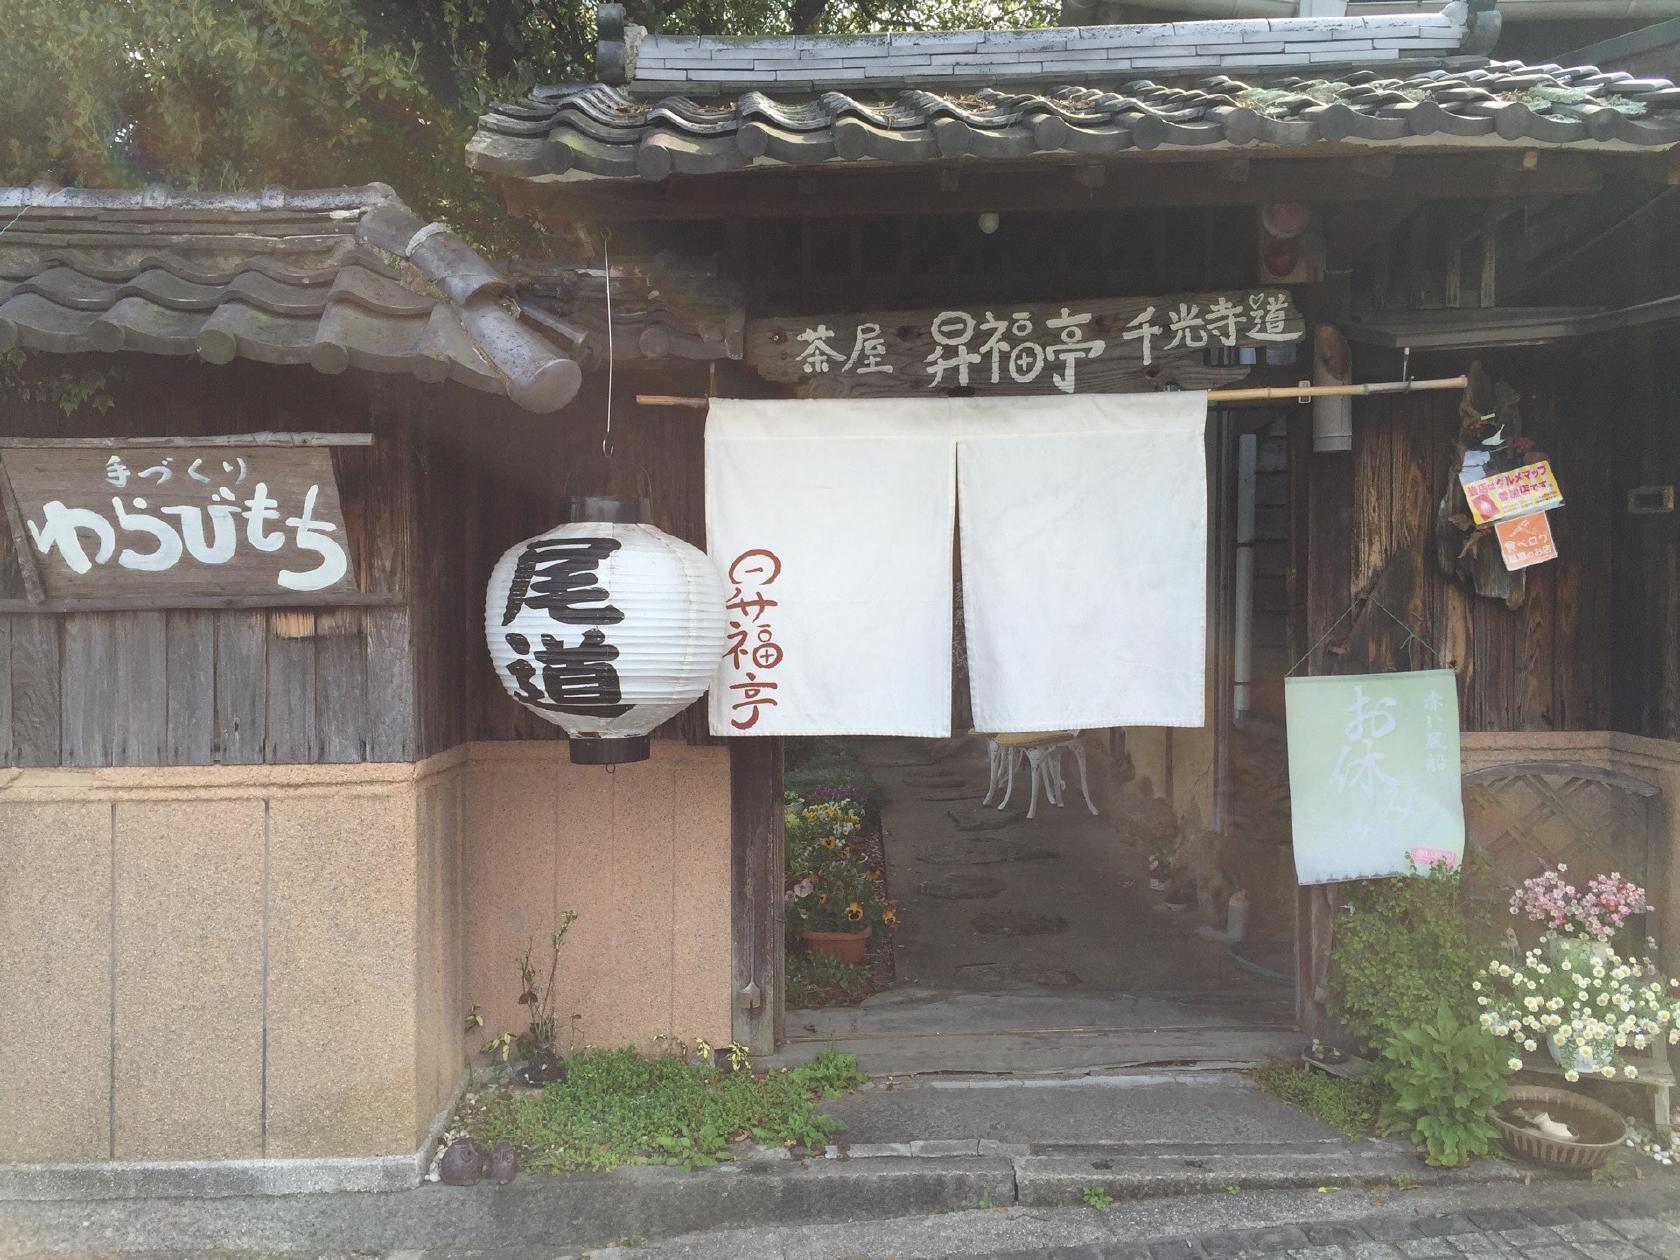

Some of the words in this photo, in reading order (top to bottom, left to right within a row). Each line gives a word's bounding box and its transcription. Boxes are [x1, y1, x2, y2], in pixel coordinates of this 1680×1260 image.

[796, 324, 894, 374] 茶屋
[1122, 293, 1303, 366] 千光寺道
[106, 455, 247, 487] 手づくり
[27, 482, 348, 591] わらびもち
[501, 537, 637, 719] 尾道
